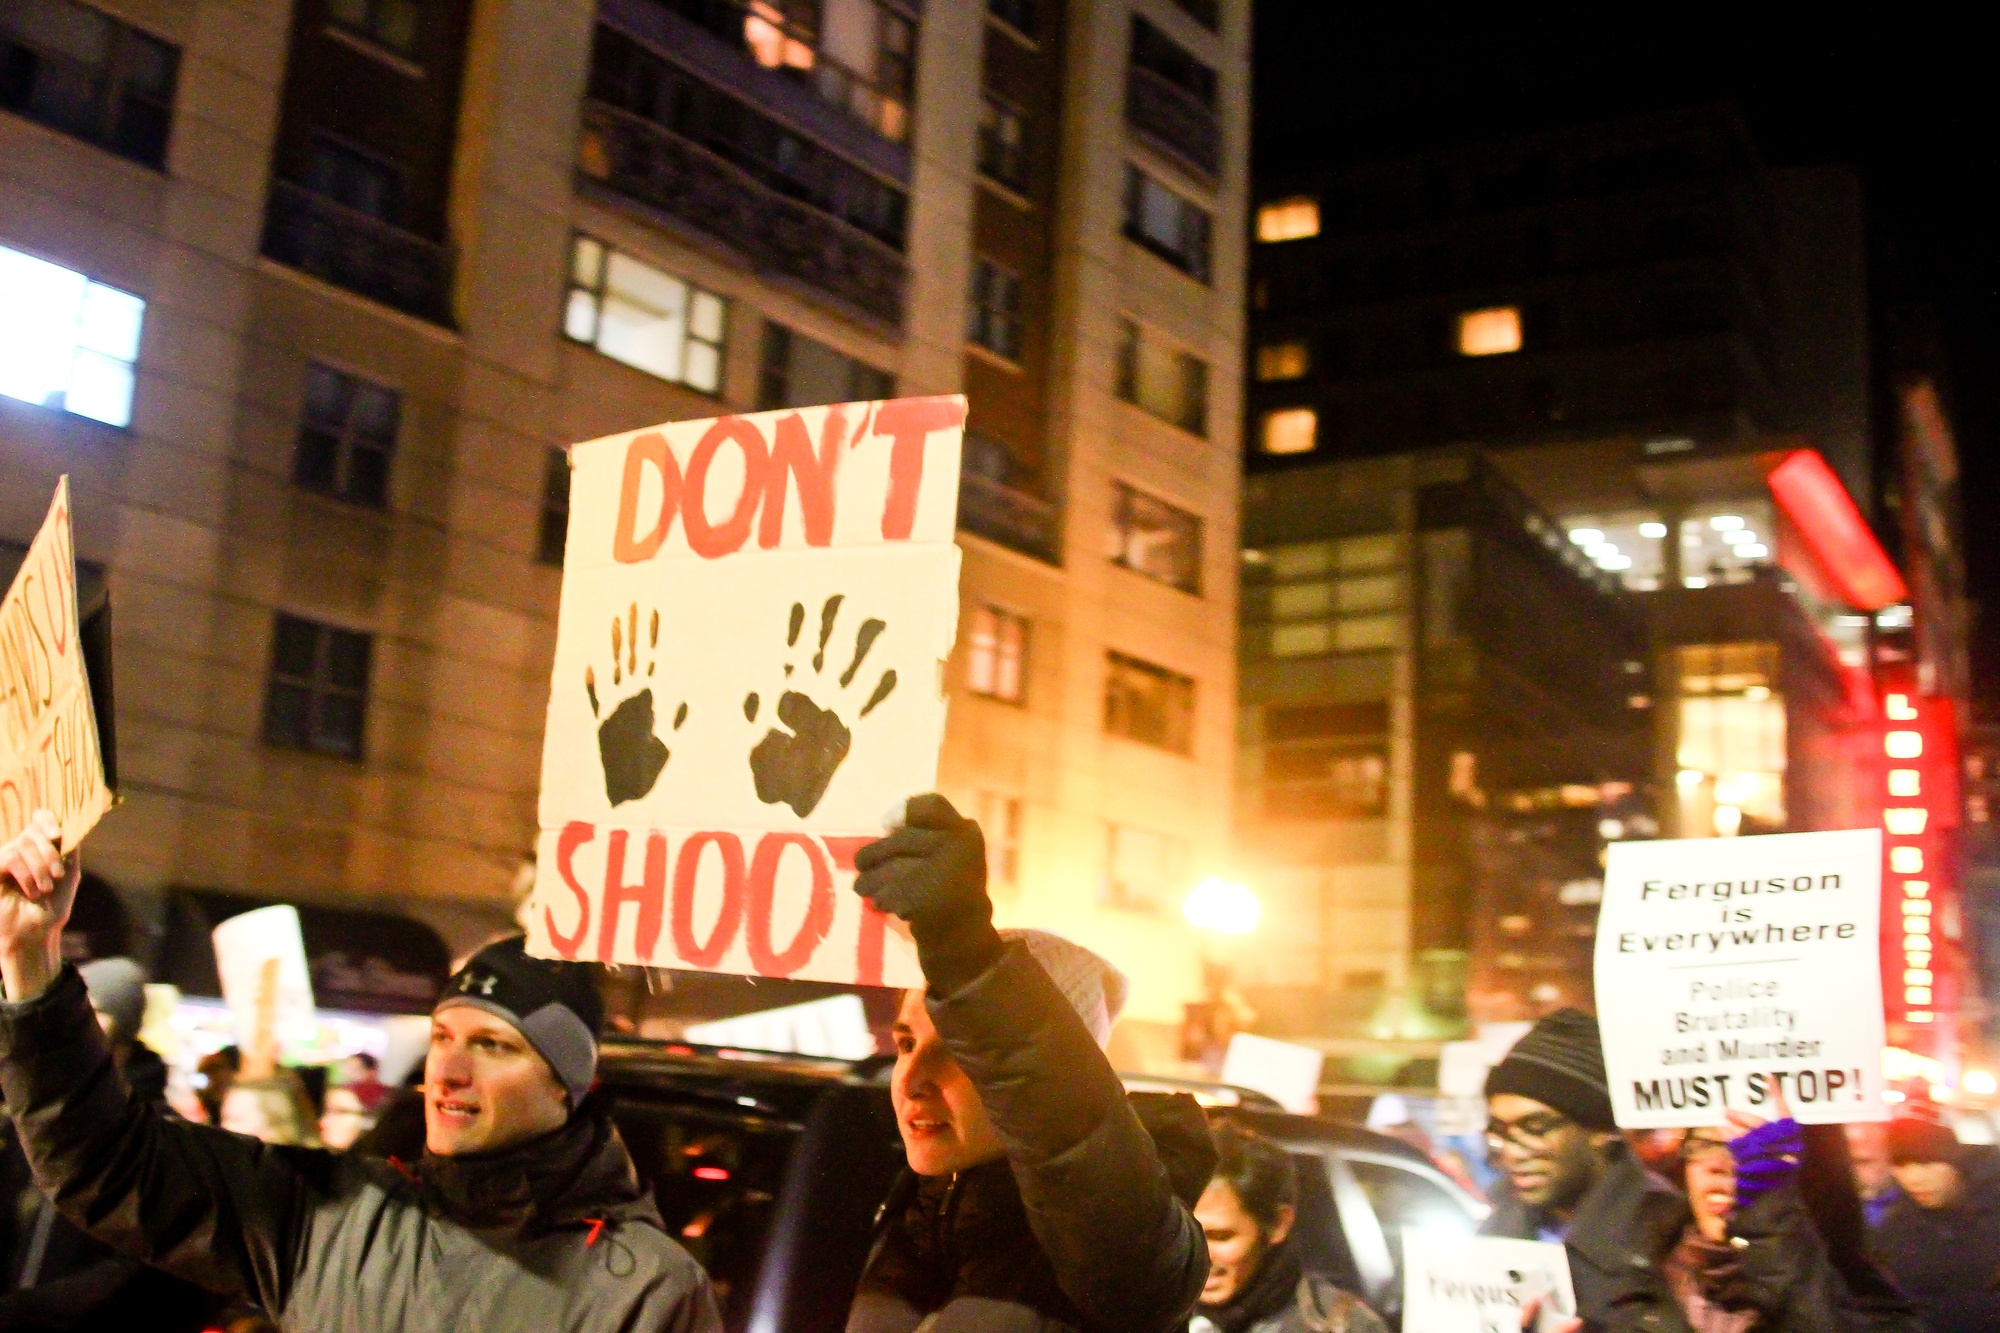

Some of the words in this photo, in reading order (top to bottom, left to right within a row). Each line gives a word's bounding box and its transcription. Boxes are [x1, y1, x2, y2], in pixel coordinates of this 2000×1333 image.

[613, 397, 963, 564] DON'T
[1641, 872, 1842, 902] Ferguson
[545, 820, 888, 986] SHOOT
[1721, 905, 1753, 924] is
[1618, 921, 1857, 953] Everywhere
[1689, 978, 1781, 1002] Police
[1675, 1006, 1798, 1034] Brutality
[1661, 1042, 1708, 1066] and
[1717, 1036, 1824, 1062] Murder
[1631, 1073, 1732, 1112] MUST
[1746, 1068, 1864, 1107] STOP!
